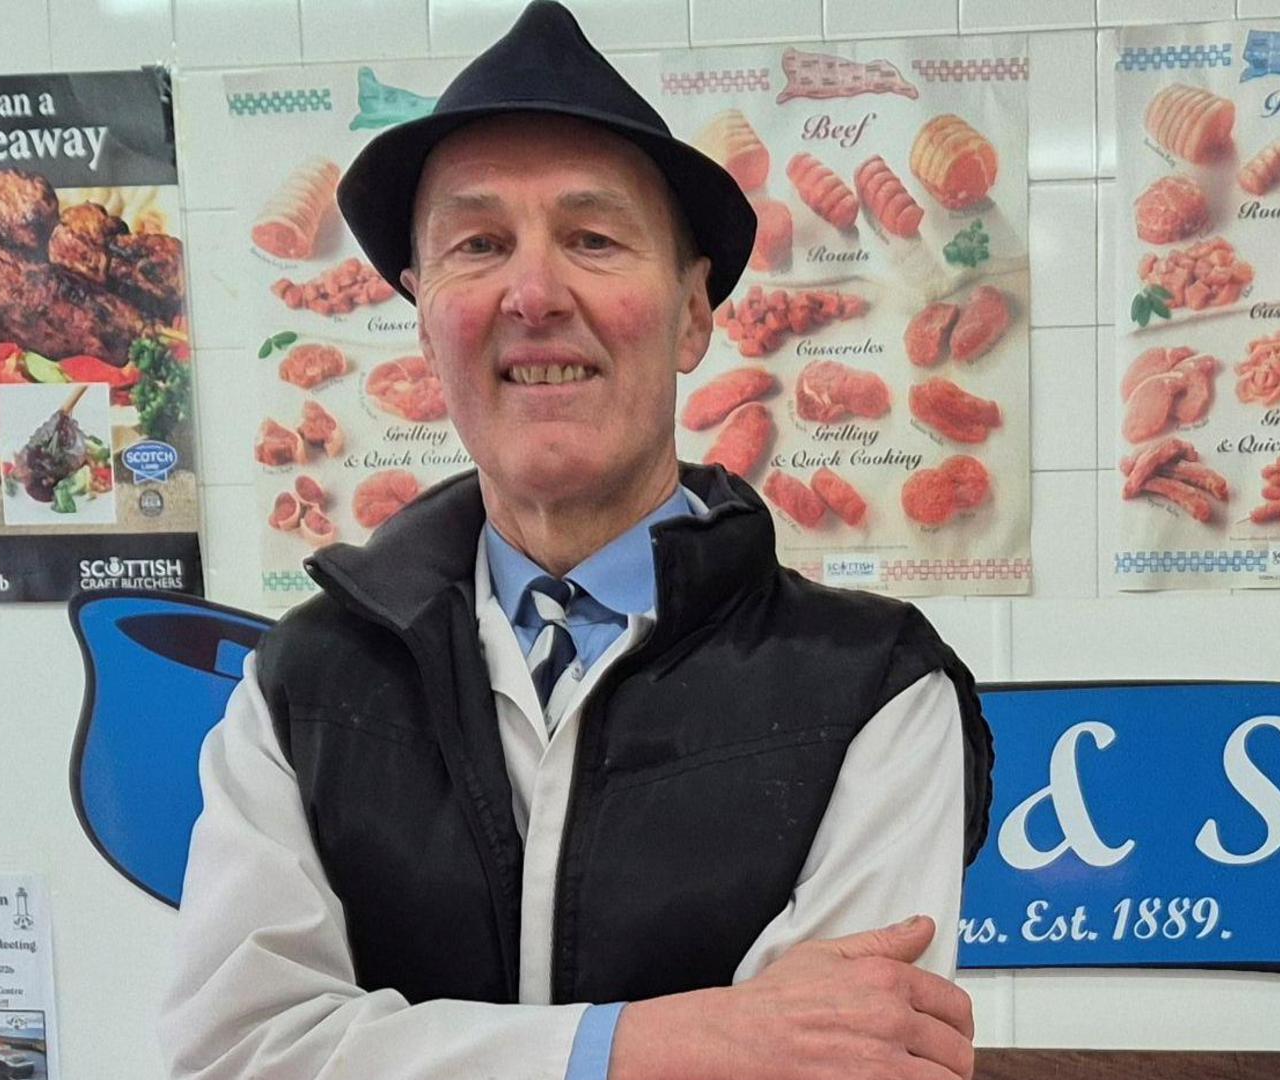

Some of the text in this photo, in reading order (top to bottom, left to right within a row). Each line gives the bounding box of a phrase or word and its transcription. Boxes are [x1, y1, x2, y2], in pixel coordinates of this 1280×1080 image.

[38, 92, 56, 116] a
[801, 113, 877, 148] Beef
[806, 245, 870, 263] Roasts
[368, 316, 418, 332] Casser
[796, 339, 884, 356] Casseroles
[383, 425, 448, 445] Grilling
[812, 424, 880, 446] Grilling
[1217, 439, 1232, 453] &
[126, 451, 174, 463] SCOTCH
[344, 457, 359, 468] &
[363, 450, 413, 470] Quick
[771, 448, 923, 471] & Quick Cooking
[80, 557, 182, 578] SCOTTISH
[80, 577, 183, 590] CRAFT BUTCHERS
[997, 721, 1136, 870] &
[1021, 896, 1233, 941] Est. 1889.
